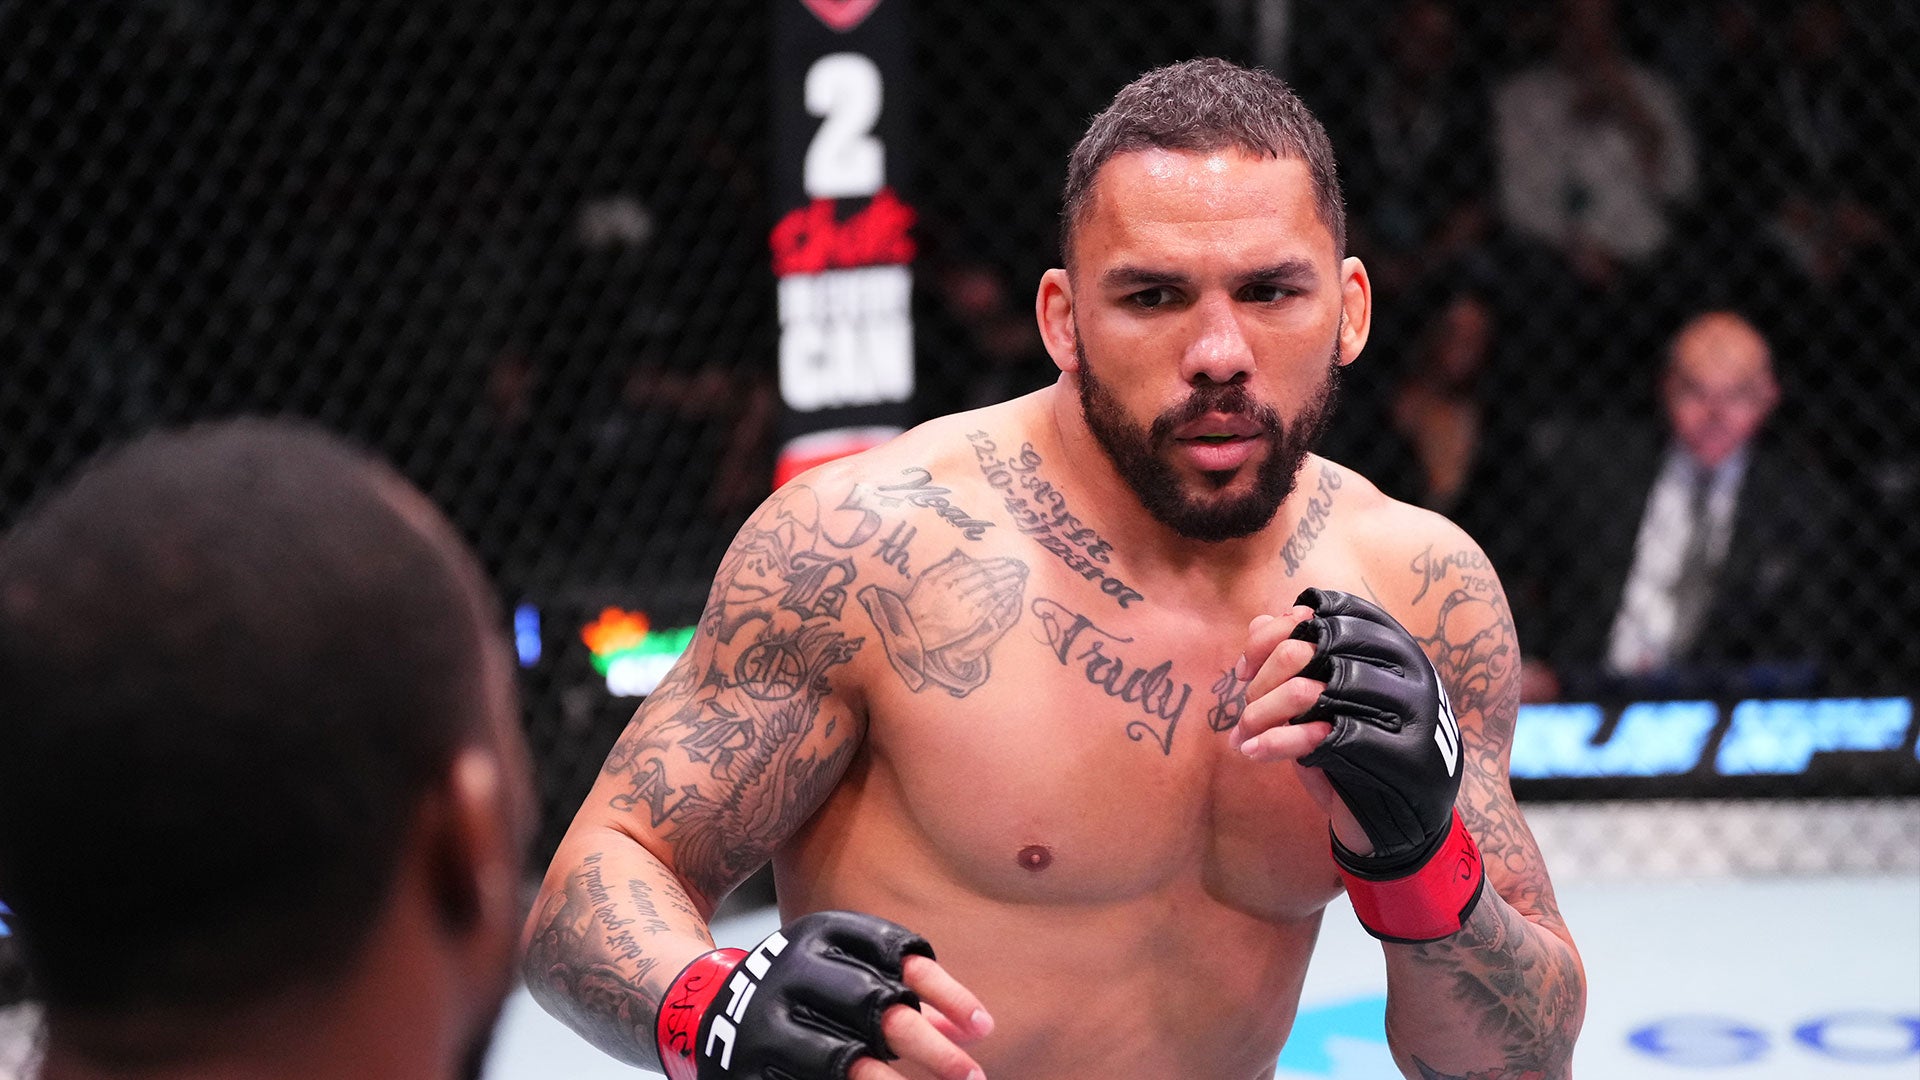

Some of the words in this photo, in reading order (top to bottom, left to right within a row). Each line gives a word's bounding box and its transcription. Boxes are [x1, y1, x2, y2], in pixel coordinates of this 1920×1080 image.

[803, 52, 886, 198] 2
[878, 467, 995, 541] Noah
[1030, 597, 1192, 755] Truly
[605, 926, 643, 961] debt
[705, 931, 789, 1071] UFC
